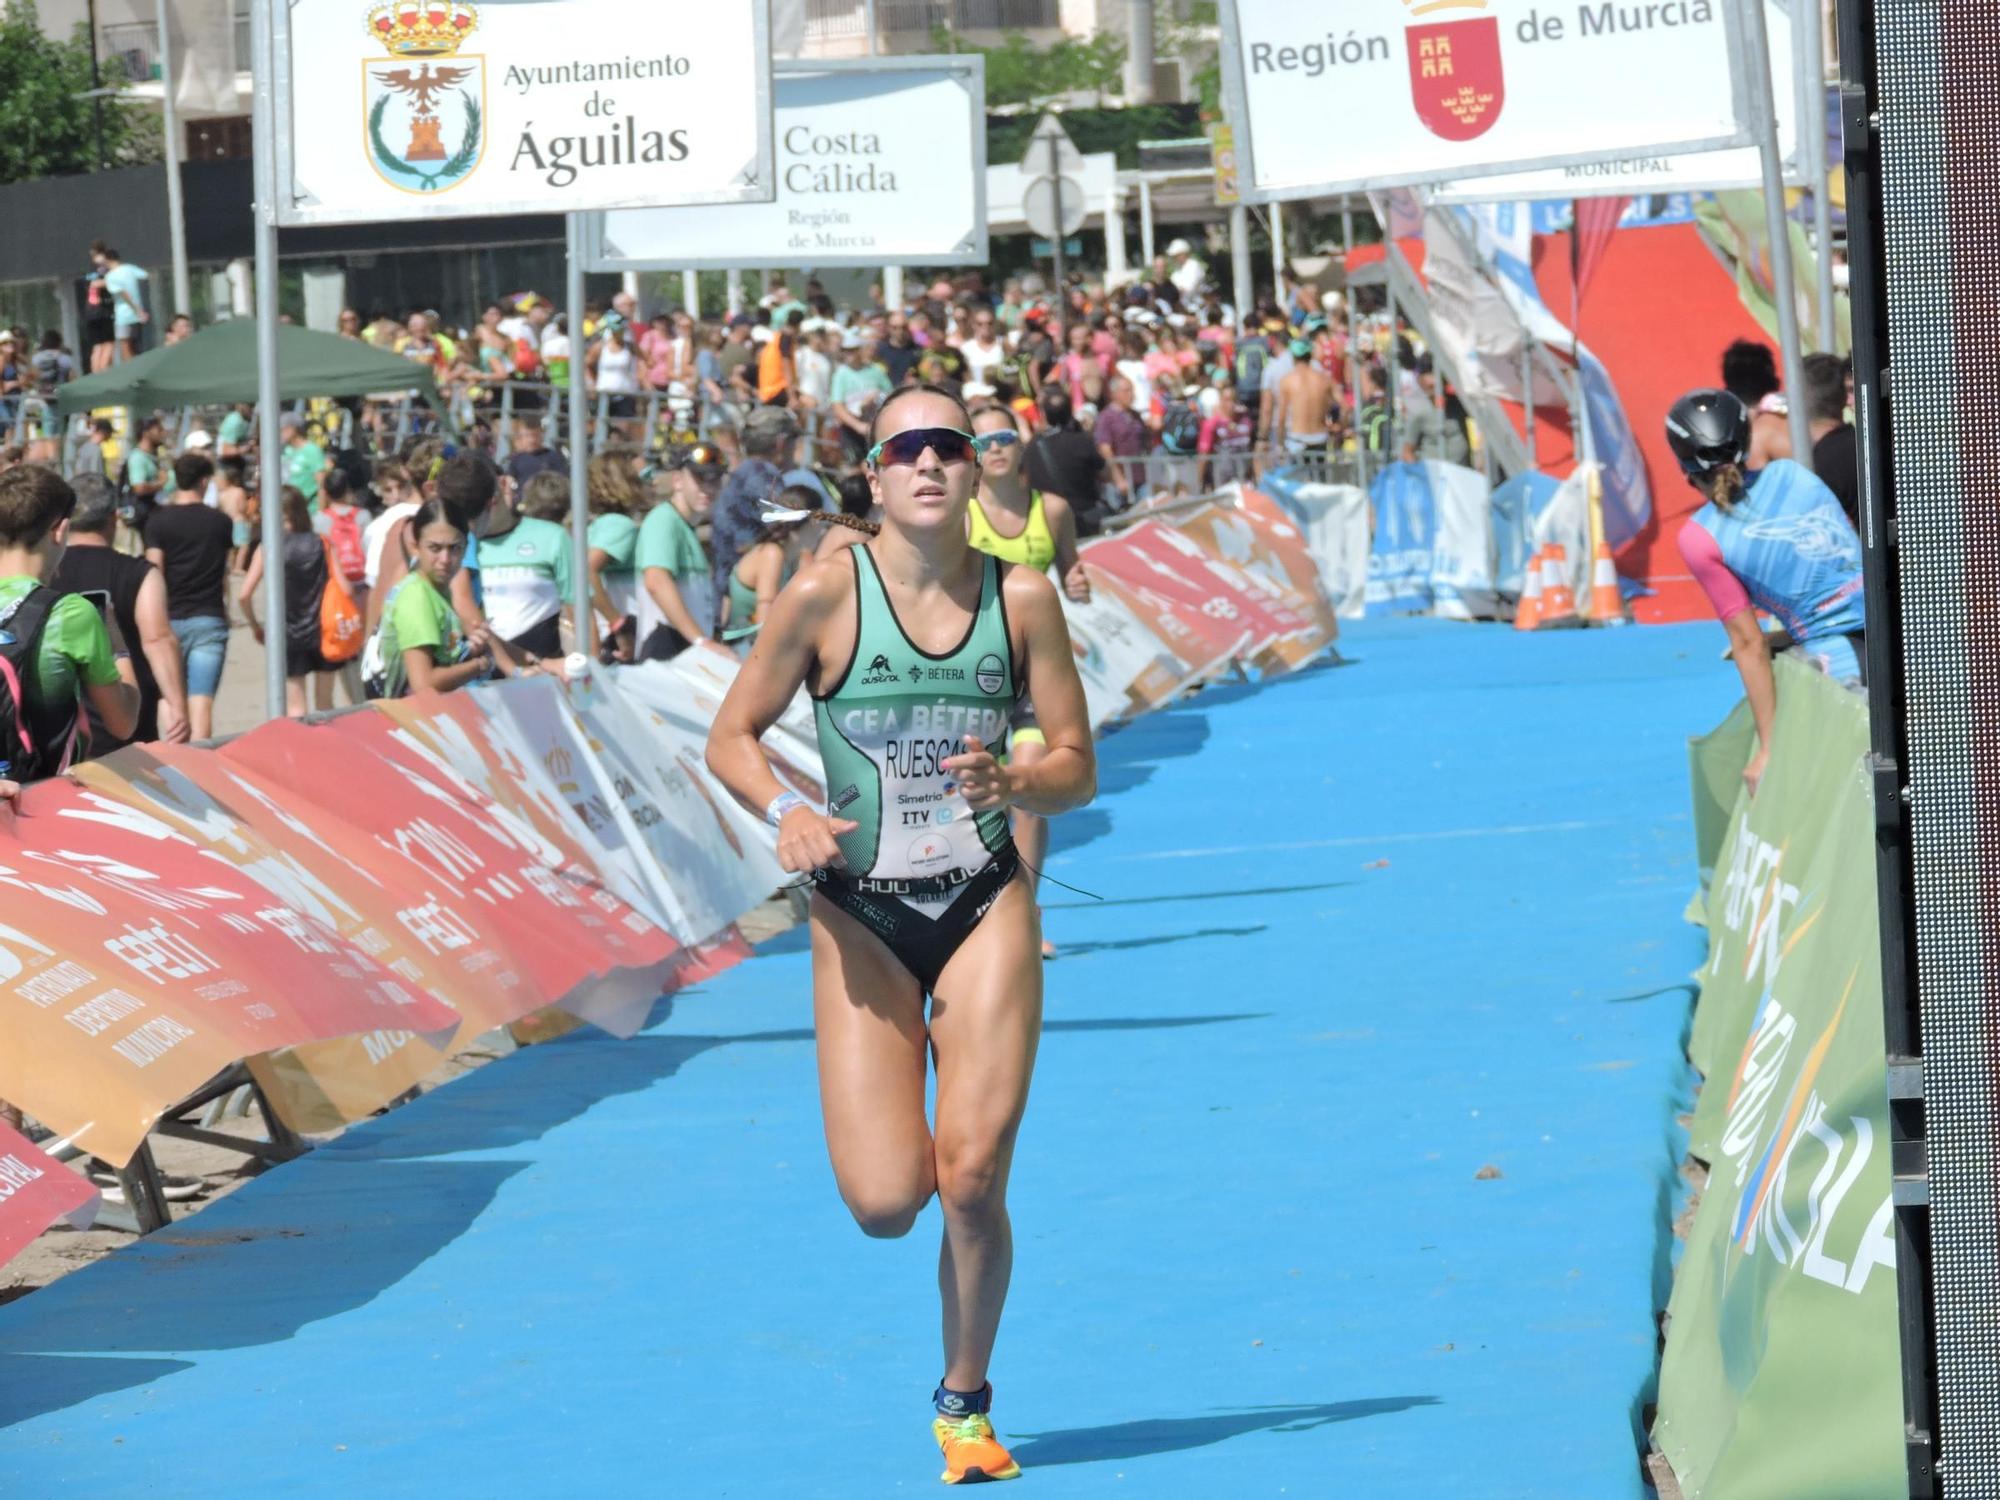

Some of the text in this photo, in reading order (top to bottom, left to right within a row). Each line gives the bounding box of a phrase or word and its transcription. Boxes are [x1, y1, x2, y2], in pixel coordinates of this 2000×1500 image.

[1516, 0, 1713, 43] de Murcia
[1250, 30, 1390, 76] Región
[504, 54, 690, 96] Ayuntamiento
[584, 90, 616, 117] de
[510, 115, 690, 188] Águilas
[784, 125, 881, 156] Costa
[785, 162, 898, 193] Cálida
[1564, 157, 1673, 178] MUNICIPAL
[787, 208, 851, 229] Región
[787, 232, 877, 248] de Murcia
[928, 666, 965, 681] BÉTERA
[844, 706, 899, 735] CEA
[902, 809, 930, 825] ITV
[13, 959, 98, 1009] PATRONATO
[63, 988, 147, 1038] DEPORTIVO
[111, 1013, 196, 1069] MUNICIPAL
